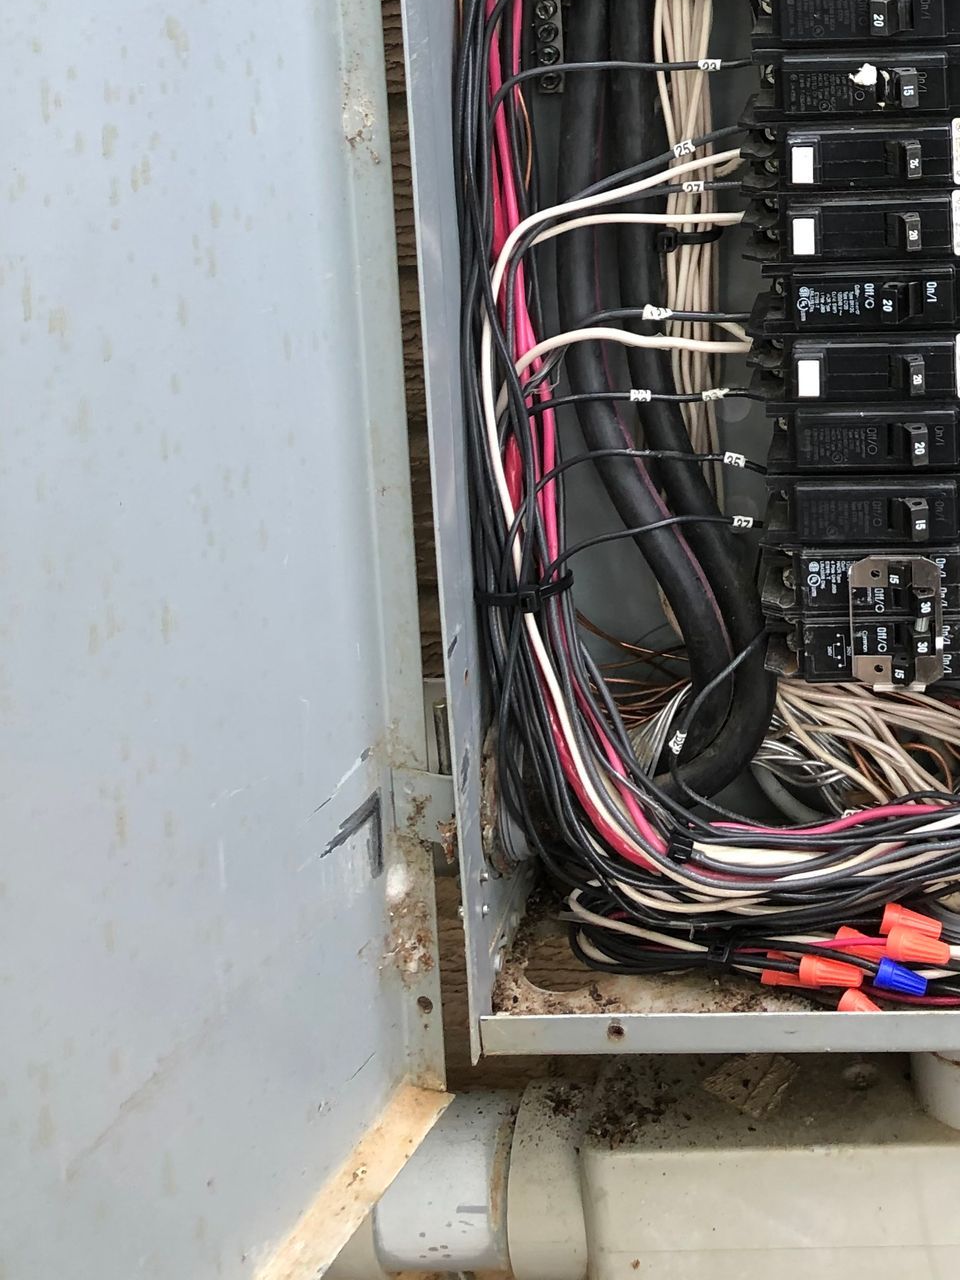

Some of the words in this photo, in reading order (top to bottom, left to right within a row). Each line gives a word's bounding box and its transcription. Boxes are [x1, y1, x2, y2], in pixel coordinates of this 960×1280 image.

[873, 13, 885, 28] 20
[903, 84, 915, 97] 15
[882, 299, 893, 312] 20
[914, 441, 926, 455] 20
[915, 519, 927, 531] 15
[889, 574, 900, 585] 15
[920, 601, 931, 614] 30
[917, 641, 929, 654] 30
[895, 668, 905, 680] 15
